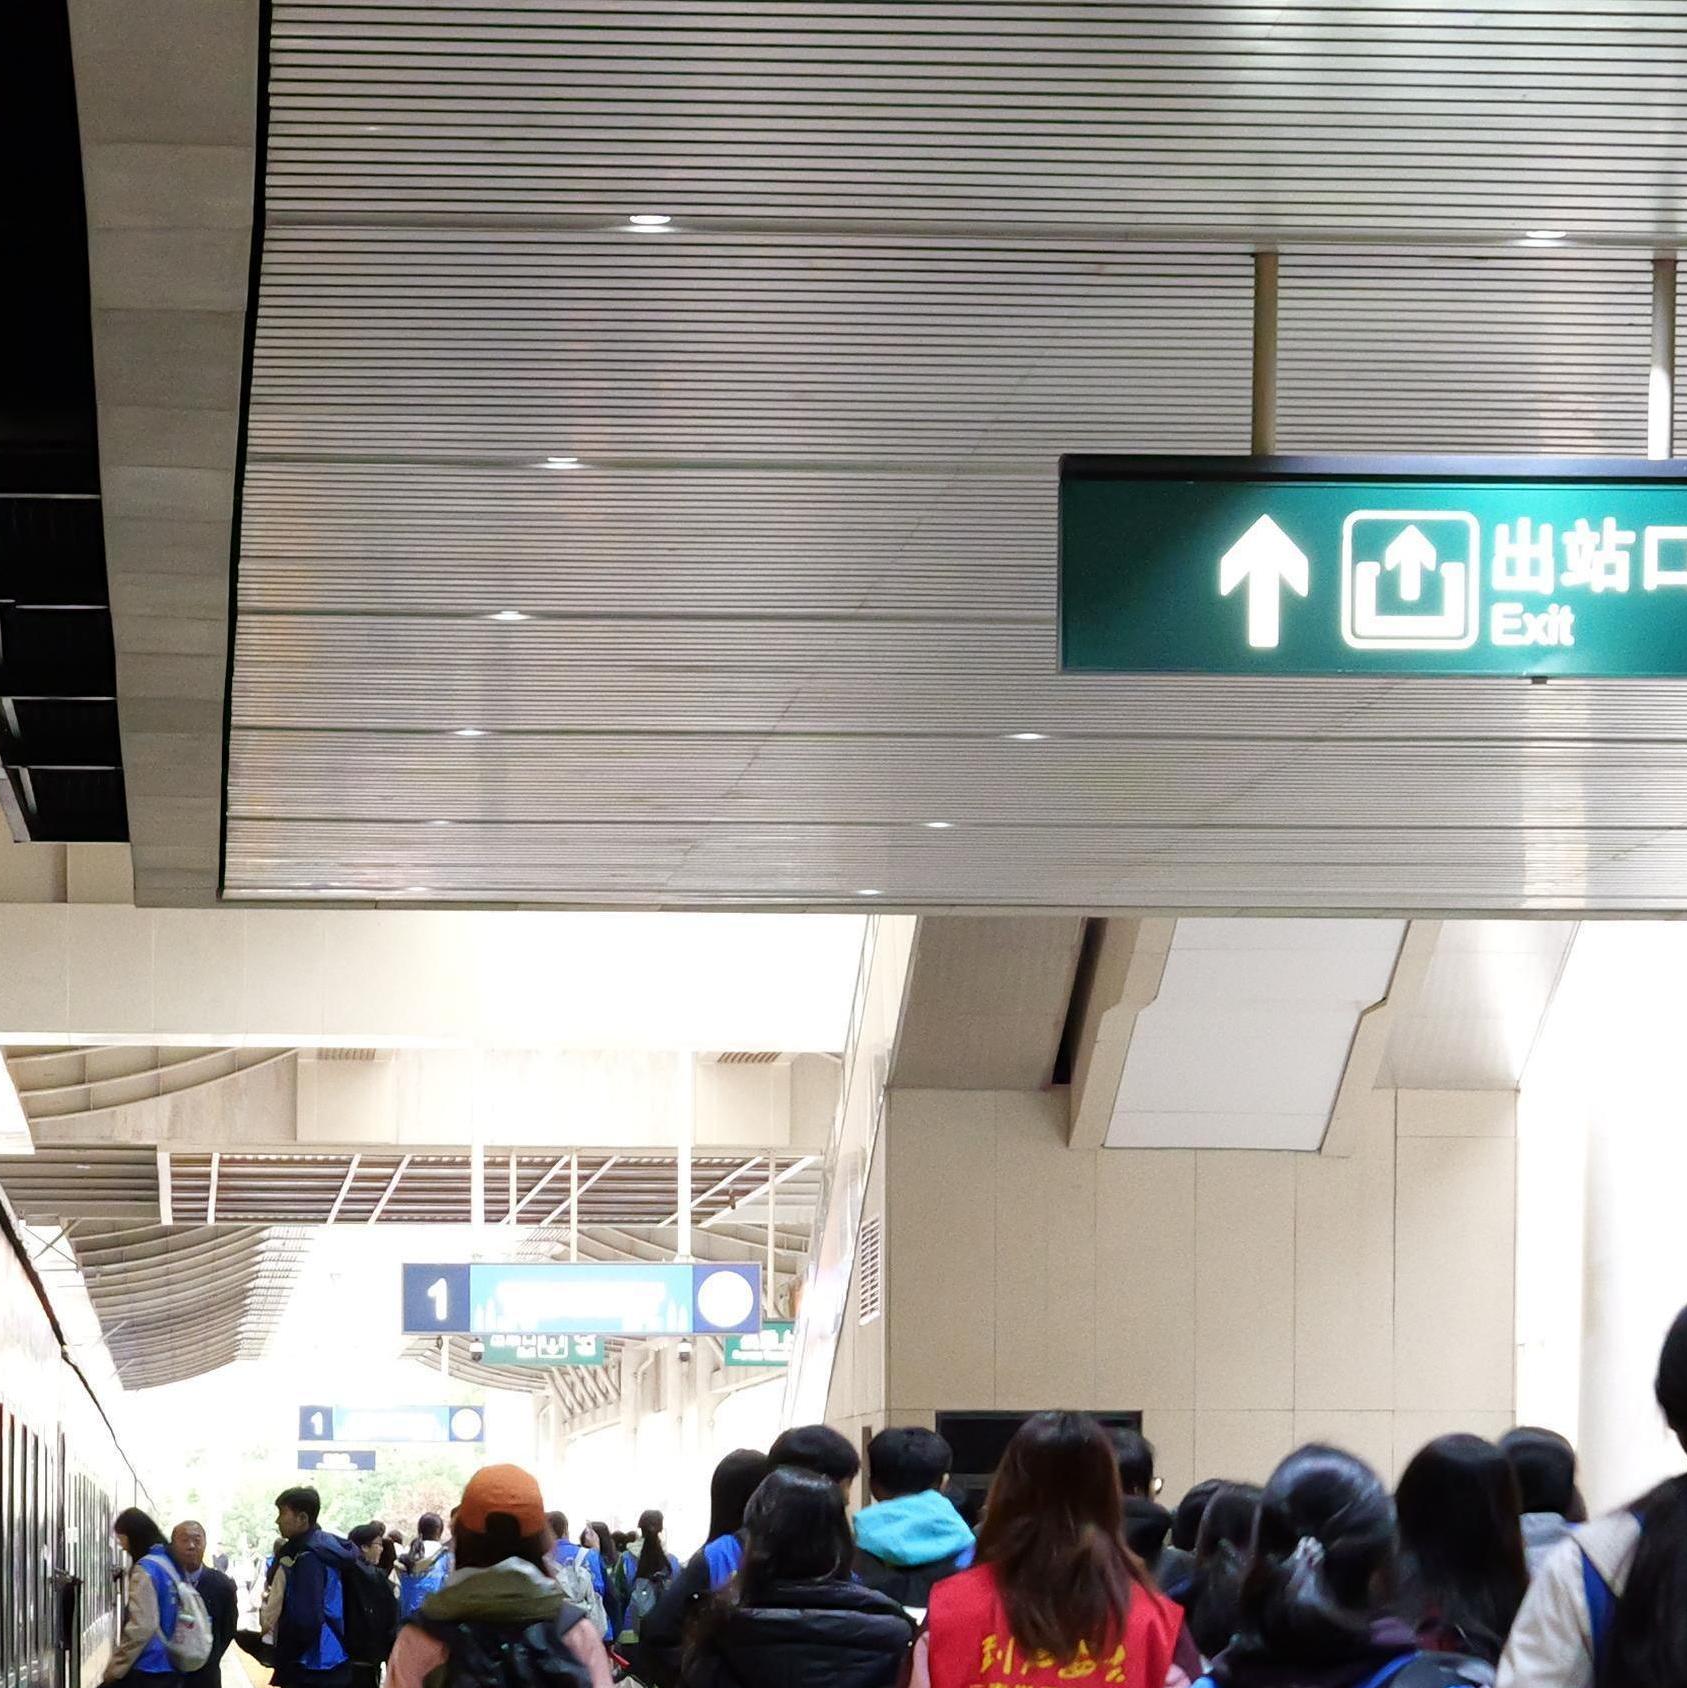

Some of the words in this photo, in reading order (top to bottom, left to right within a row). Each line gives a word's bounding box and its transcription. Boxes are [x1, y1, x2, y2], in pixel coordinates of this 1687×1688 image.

[1490, 602, 1575, 646] Exit
[426, 1276, 449, 1322] 1
[310, 1410, 324, 1436] 1
